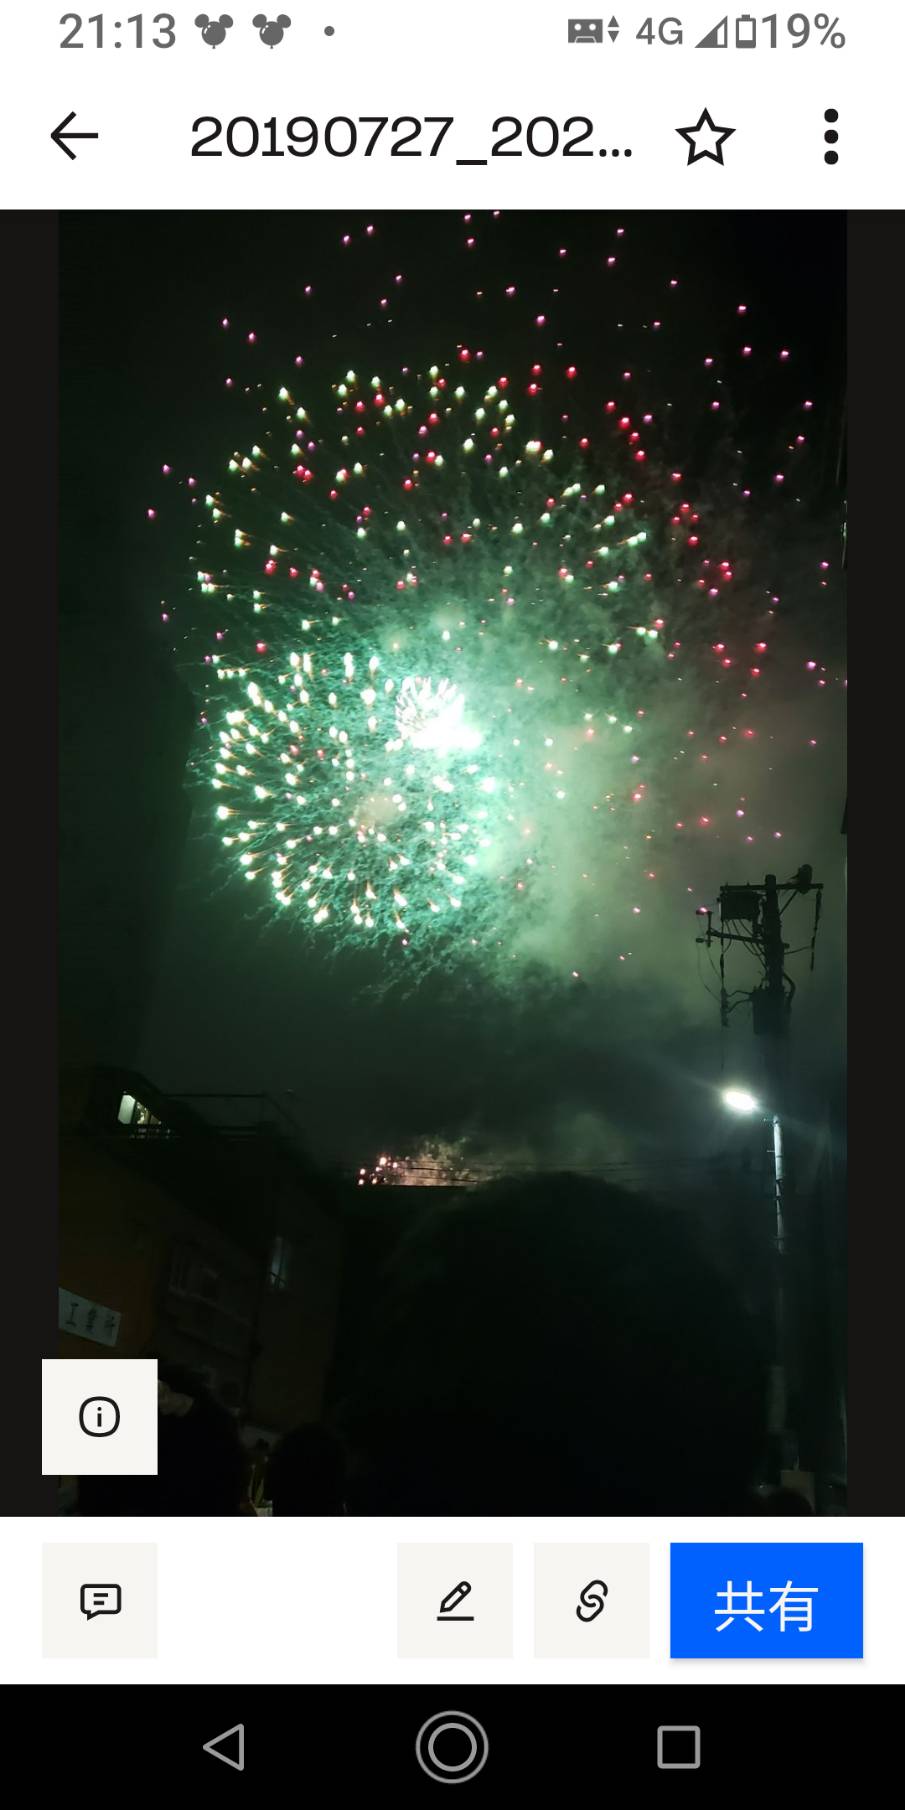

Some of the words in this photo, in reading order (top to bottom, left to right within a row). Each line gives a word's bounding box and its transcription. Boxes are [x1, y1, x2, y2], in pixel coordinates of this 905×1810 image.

[59, 12, 176, 48] 21:13
[635, 16, 684, 46] 4G
[761, 12, 846, 48] 19%
[714, 1580, 818, 1632] 共有
